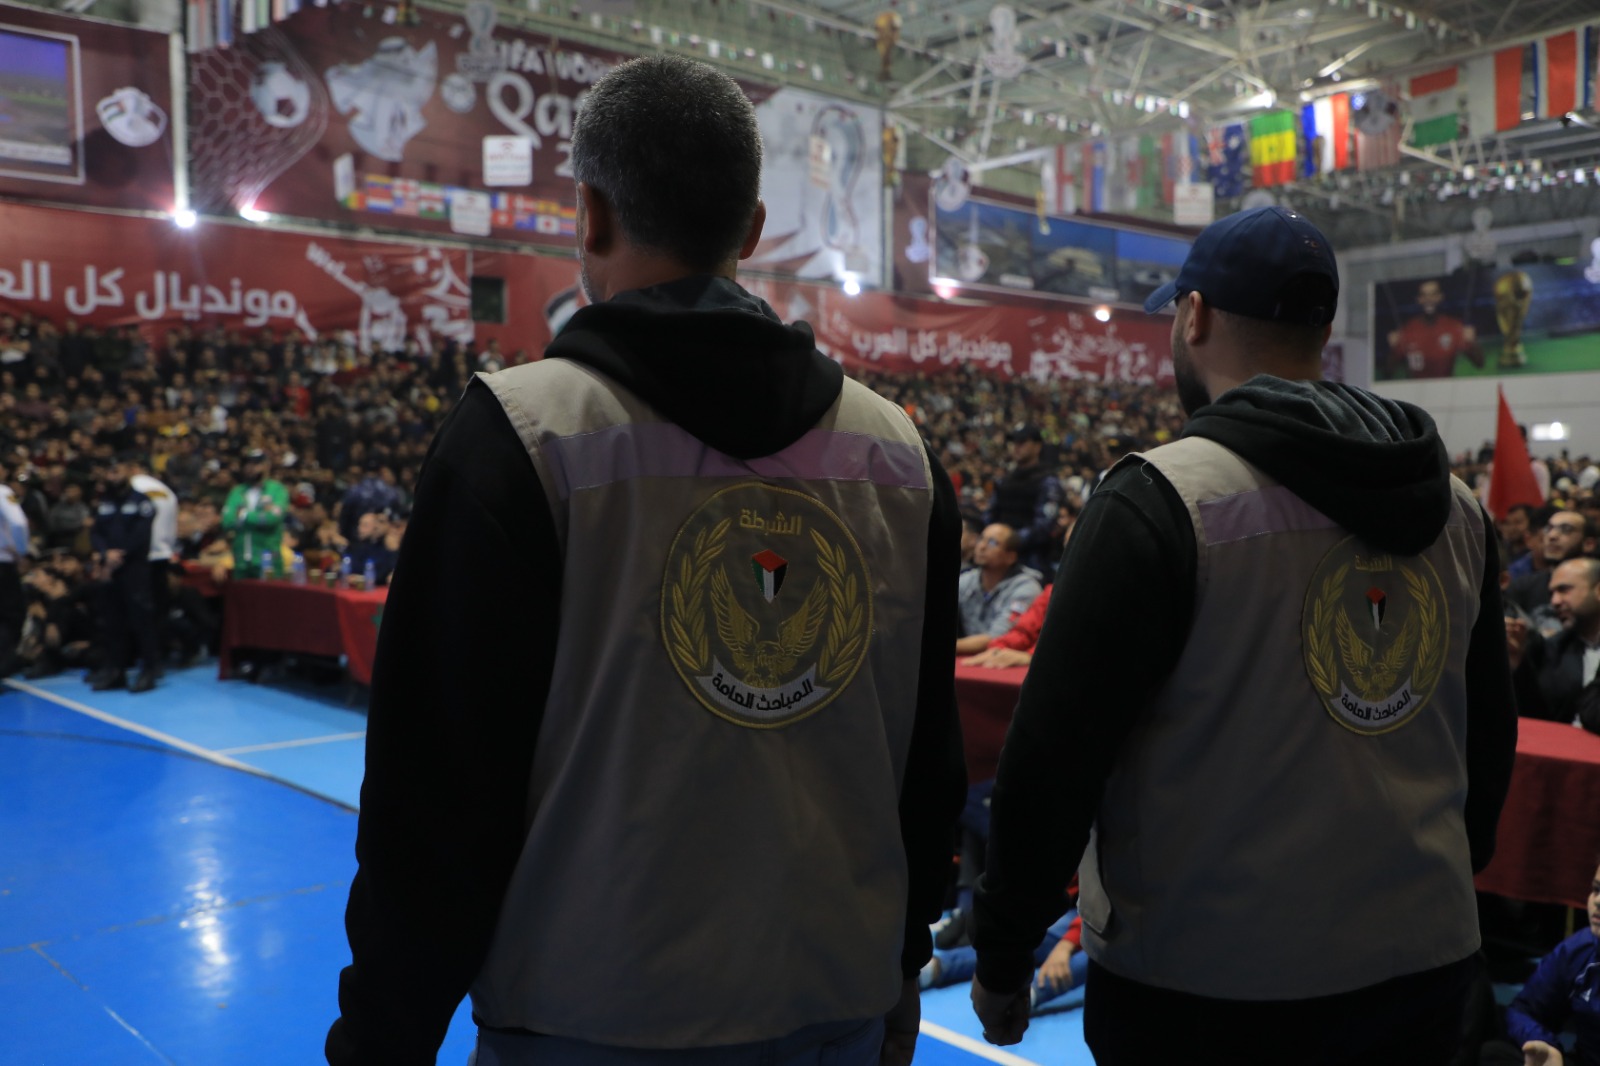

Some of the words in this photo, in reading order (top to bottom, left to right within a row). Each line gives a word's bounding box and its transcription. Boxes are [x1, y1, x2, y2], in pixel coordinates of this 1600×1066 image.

[0, 259, 51, 301] الع
[64, 264, 125, 316] كل
[135, 269, 297, 327] مونديال
[739, 508, 802, 536] الشرطة
[712, 672, 755, 709] العامة
[756, 678, 814, 711] المباحث
[1341, 693, 1372, 721] العامة
[1372, 689, 1412, 721] المباحث
